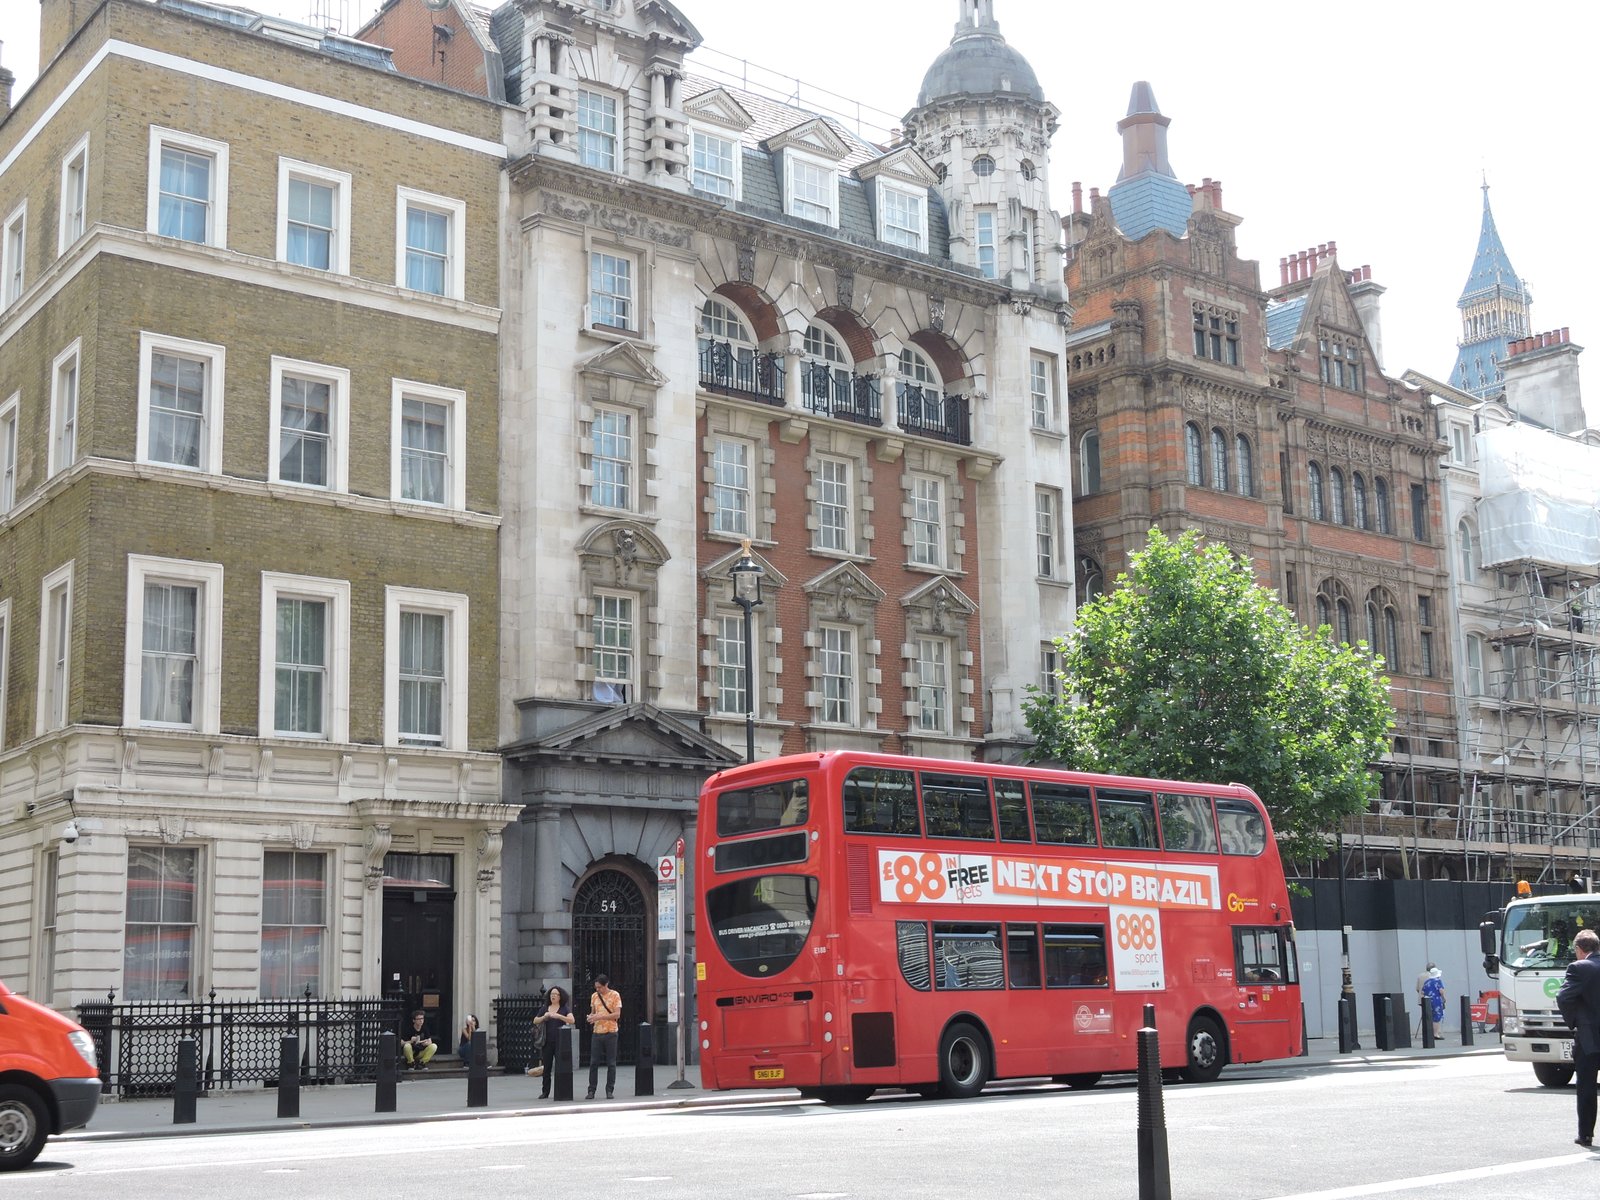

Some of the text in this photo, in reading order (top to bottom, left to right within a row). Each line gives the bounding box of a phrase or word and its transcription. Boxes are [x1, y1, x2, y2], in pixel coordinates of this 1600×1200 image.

[946, 857, 957, 869] IN
[947, 864, 989, 888] FREE
[996, 860, 1209, 906] NEXT STOP BRAZIL
[955, 882, 983, 900] bets
[601, 900, 617, 912] 54
[728, 927, 744, 935] DRIVER
[744, 924, 769, 933] VACANCIES
[1116, 913, 1156, 950] 888
[1134, 951, 1159, 966] sport
